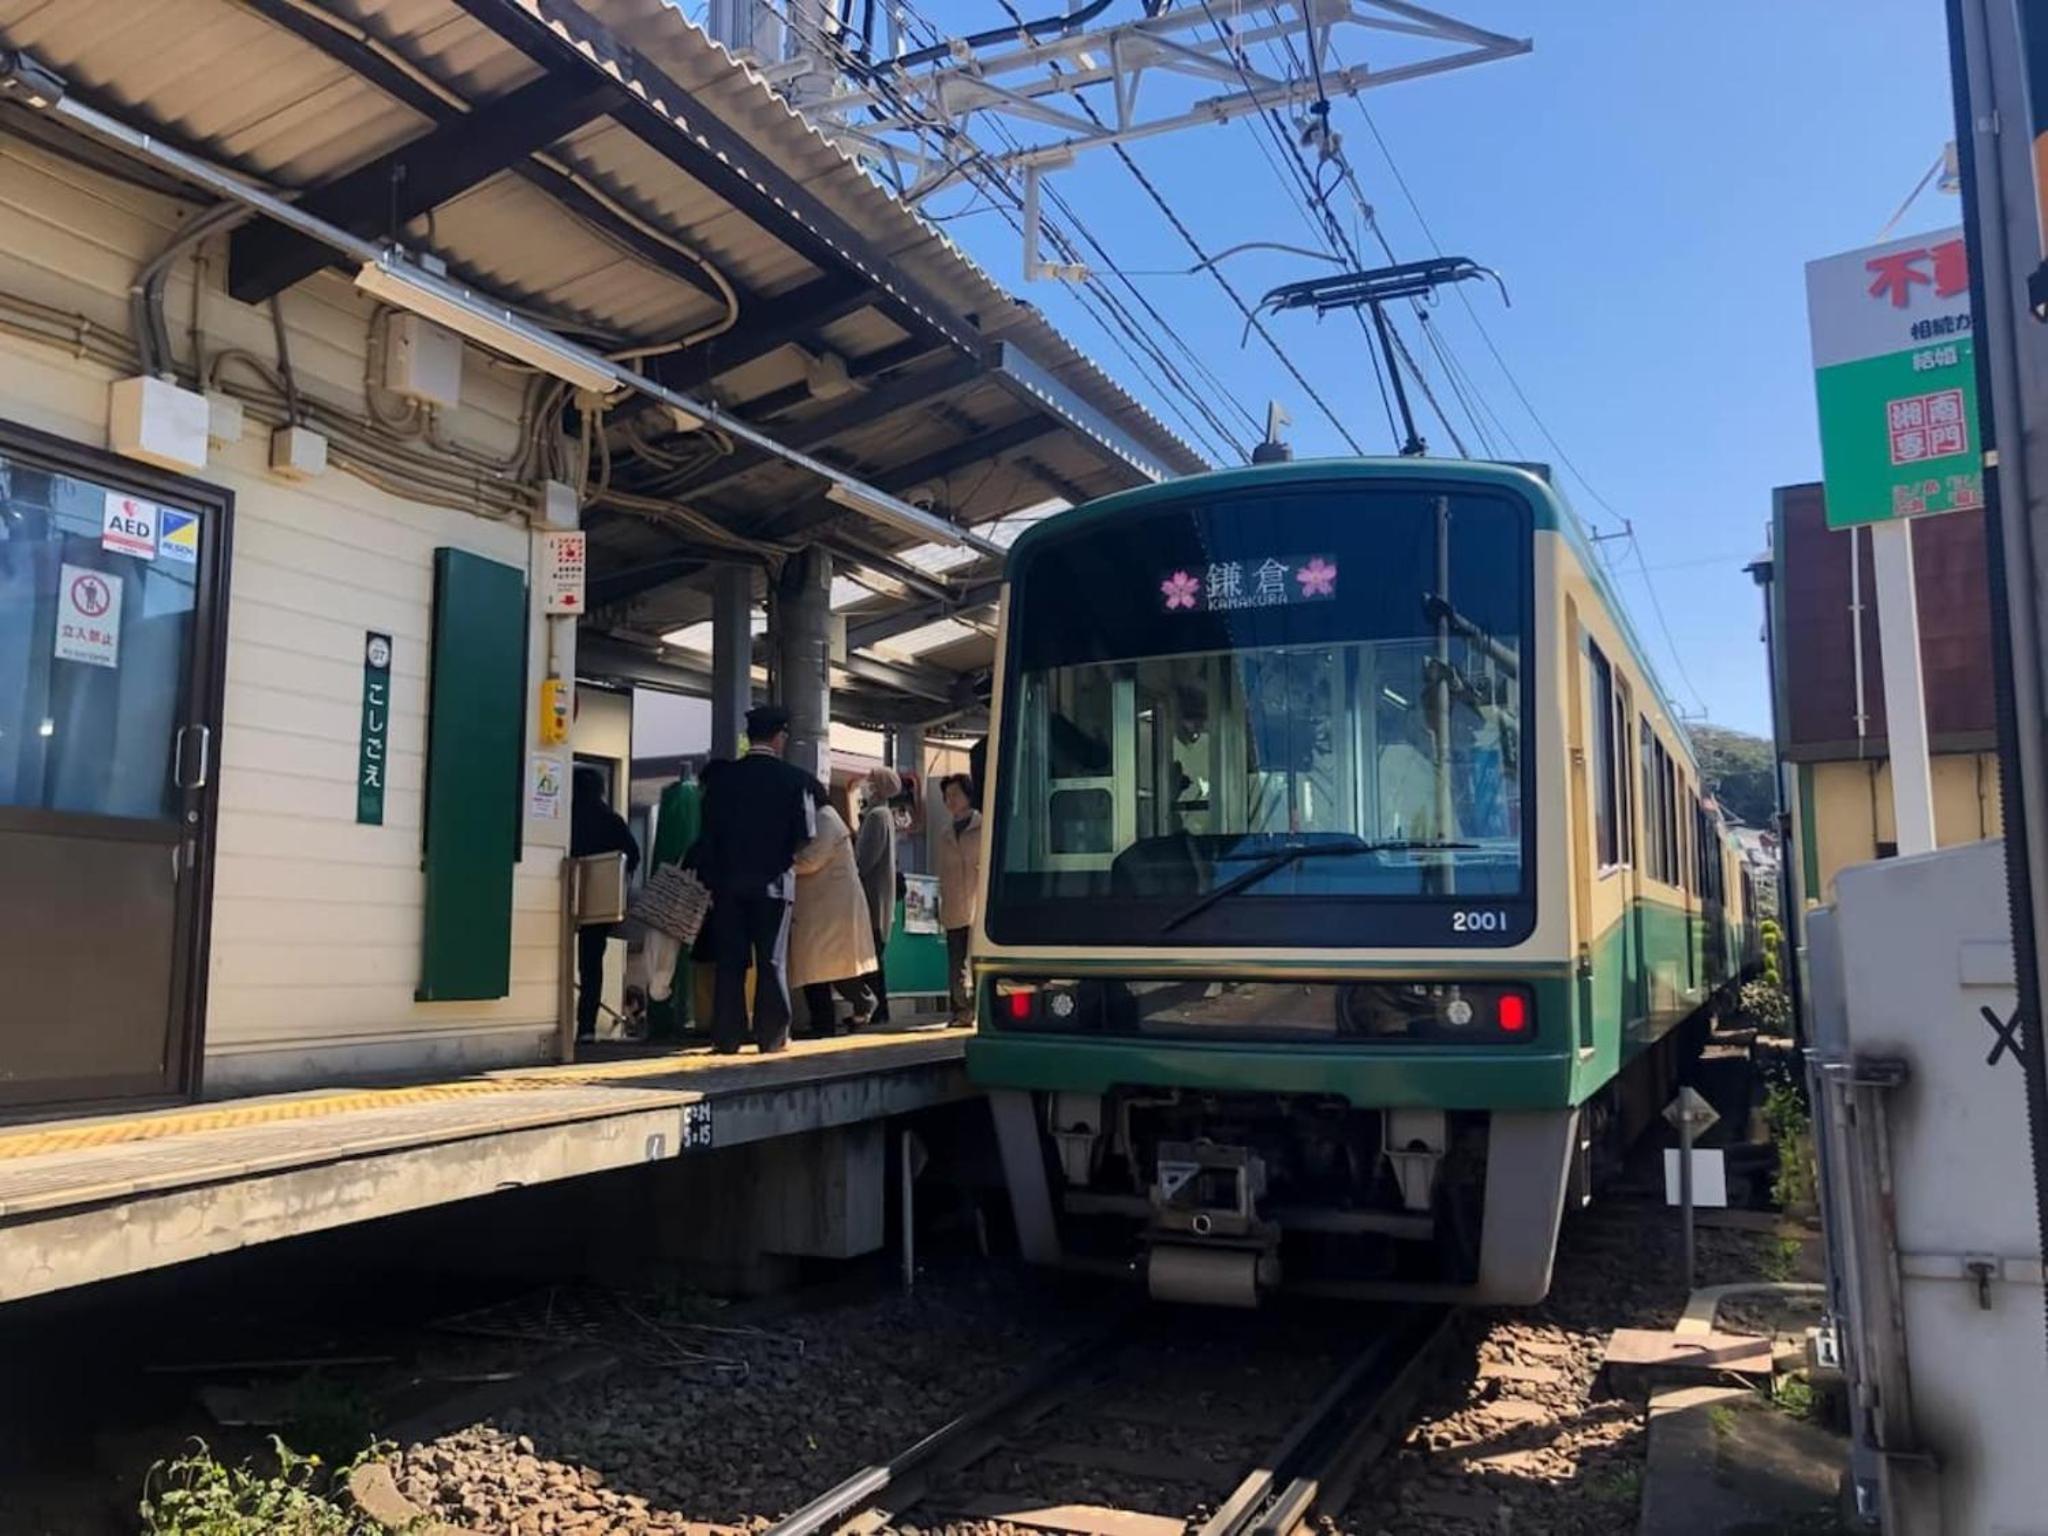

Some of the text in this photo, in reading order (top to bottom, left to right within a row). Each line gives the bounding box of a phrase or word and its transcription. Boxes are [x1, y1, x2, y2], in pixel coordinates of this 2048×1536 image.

[108, 515, 151, 539] AED
[1205, 557, 1290, 598] 鎌倉
[61, 624, 114, 647] 立入禁止
[363, 683, 384, 788] こしごえ
[1453, 911, 1507, 931] 2001
